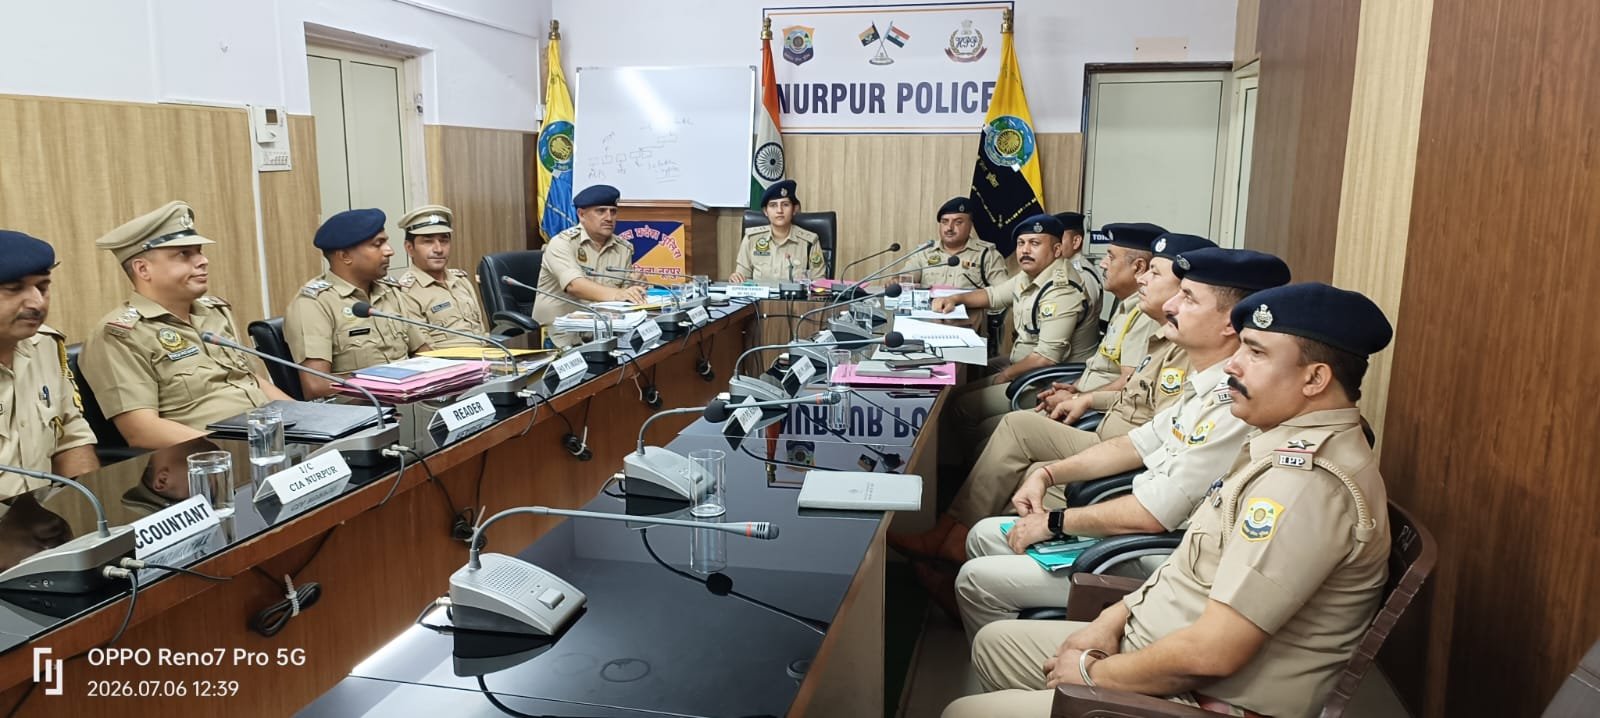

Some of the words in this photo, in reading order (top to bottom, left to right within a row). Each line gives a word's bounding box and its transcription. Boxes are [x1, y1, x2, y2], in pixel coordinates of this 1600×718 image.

[776, 82, 886, 114] NURPUR
[897, 81, 997, 113] POLICE
[453, 401, 484, 421] READER
[289, 480, 305, 492] CIA
[304, 465, 338, 485] NURPUR
[136, 503, 210, 549] CCOUNTANT
